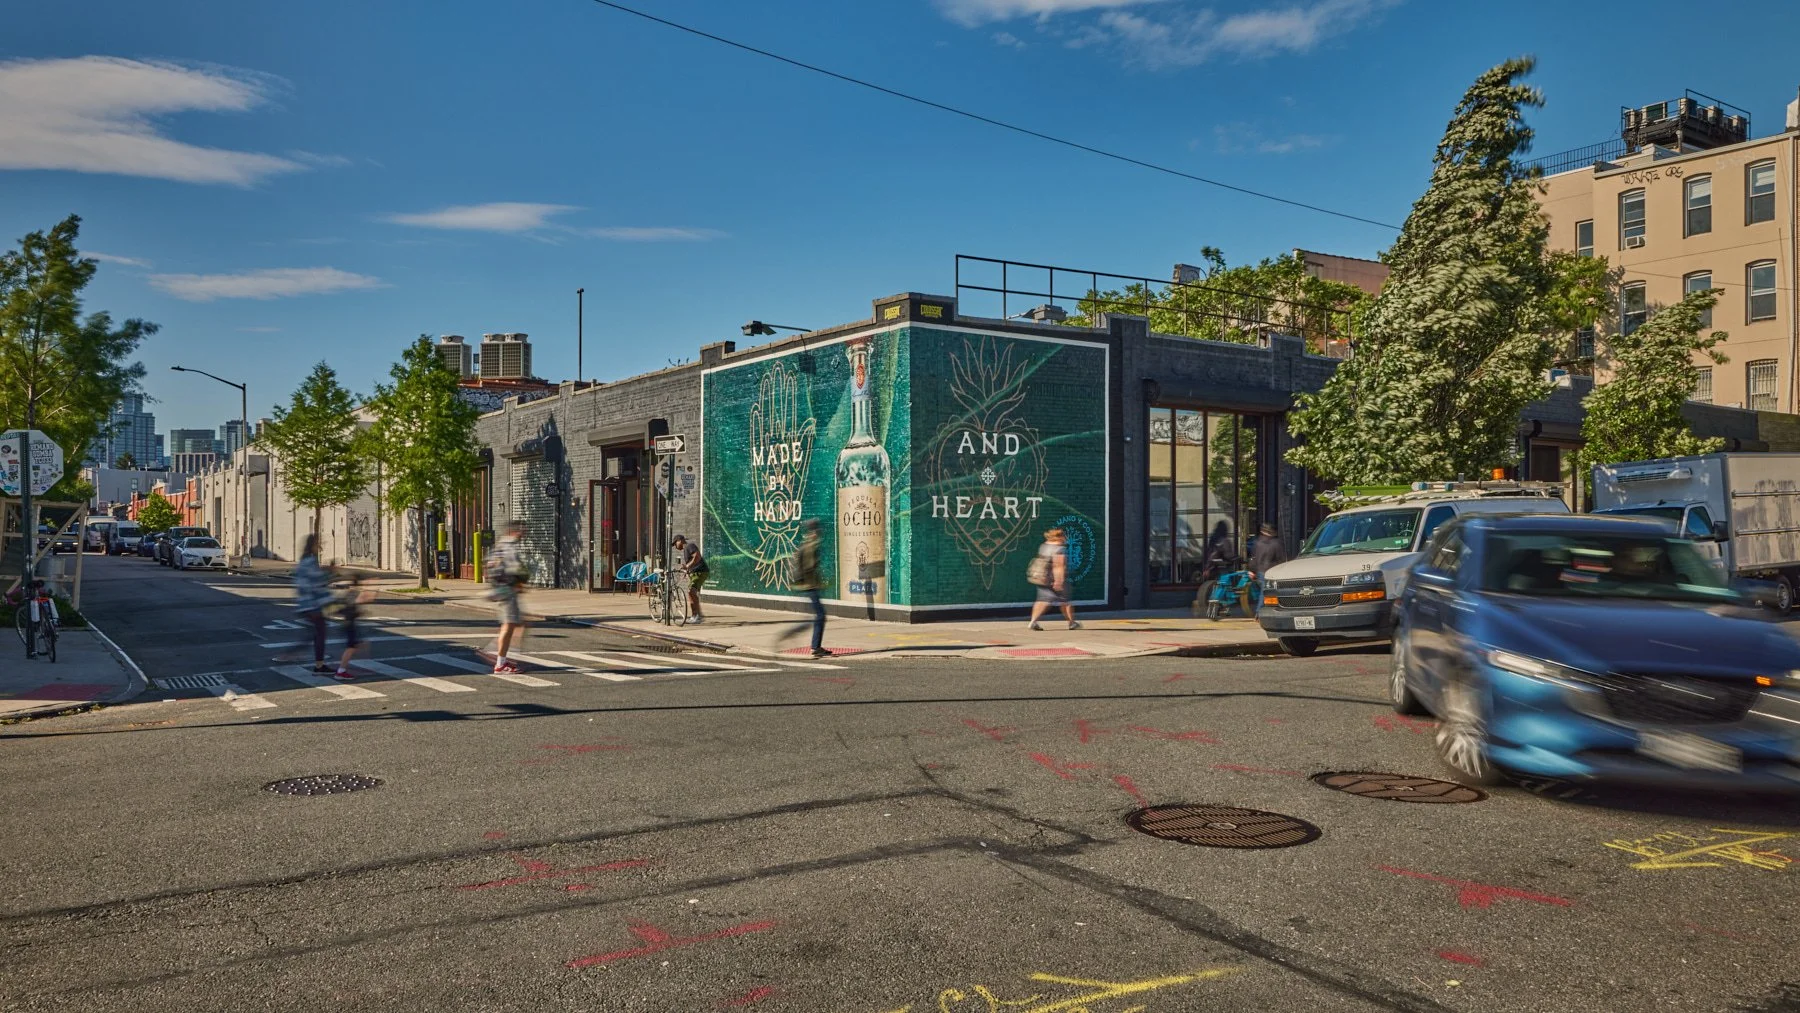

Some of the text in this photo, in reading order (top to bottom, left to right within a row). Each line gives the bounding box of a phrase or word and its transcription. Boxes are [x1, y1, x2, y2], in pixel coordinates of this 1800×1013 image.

[658, 440, 680, 449] ONE WAY
[957, 431, 1020, 456] AND
[752, 442, 804, 466] MADE
[769, 475, 786, 491] BY
[848, 495, 877, 508] TEQUILA
[931, 495, 1043, 519] HEART
[753, 500, 802, 521] HAND
[843, 511, 881, 526] OCHO
[1057, 515, 1076, 525] MANO
